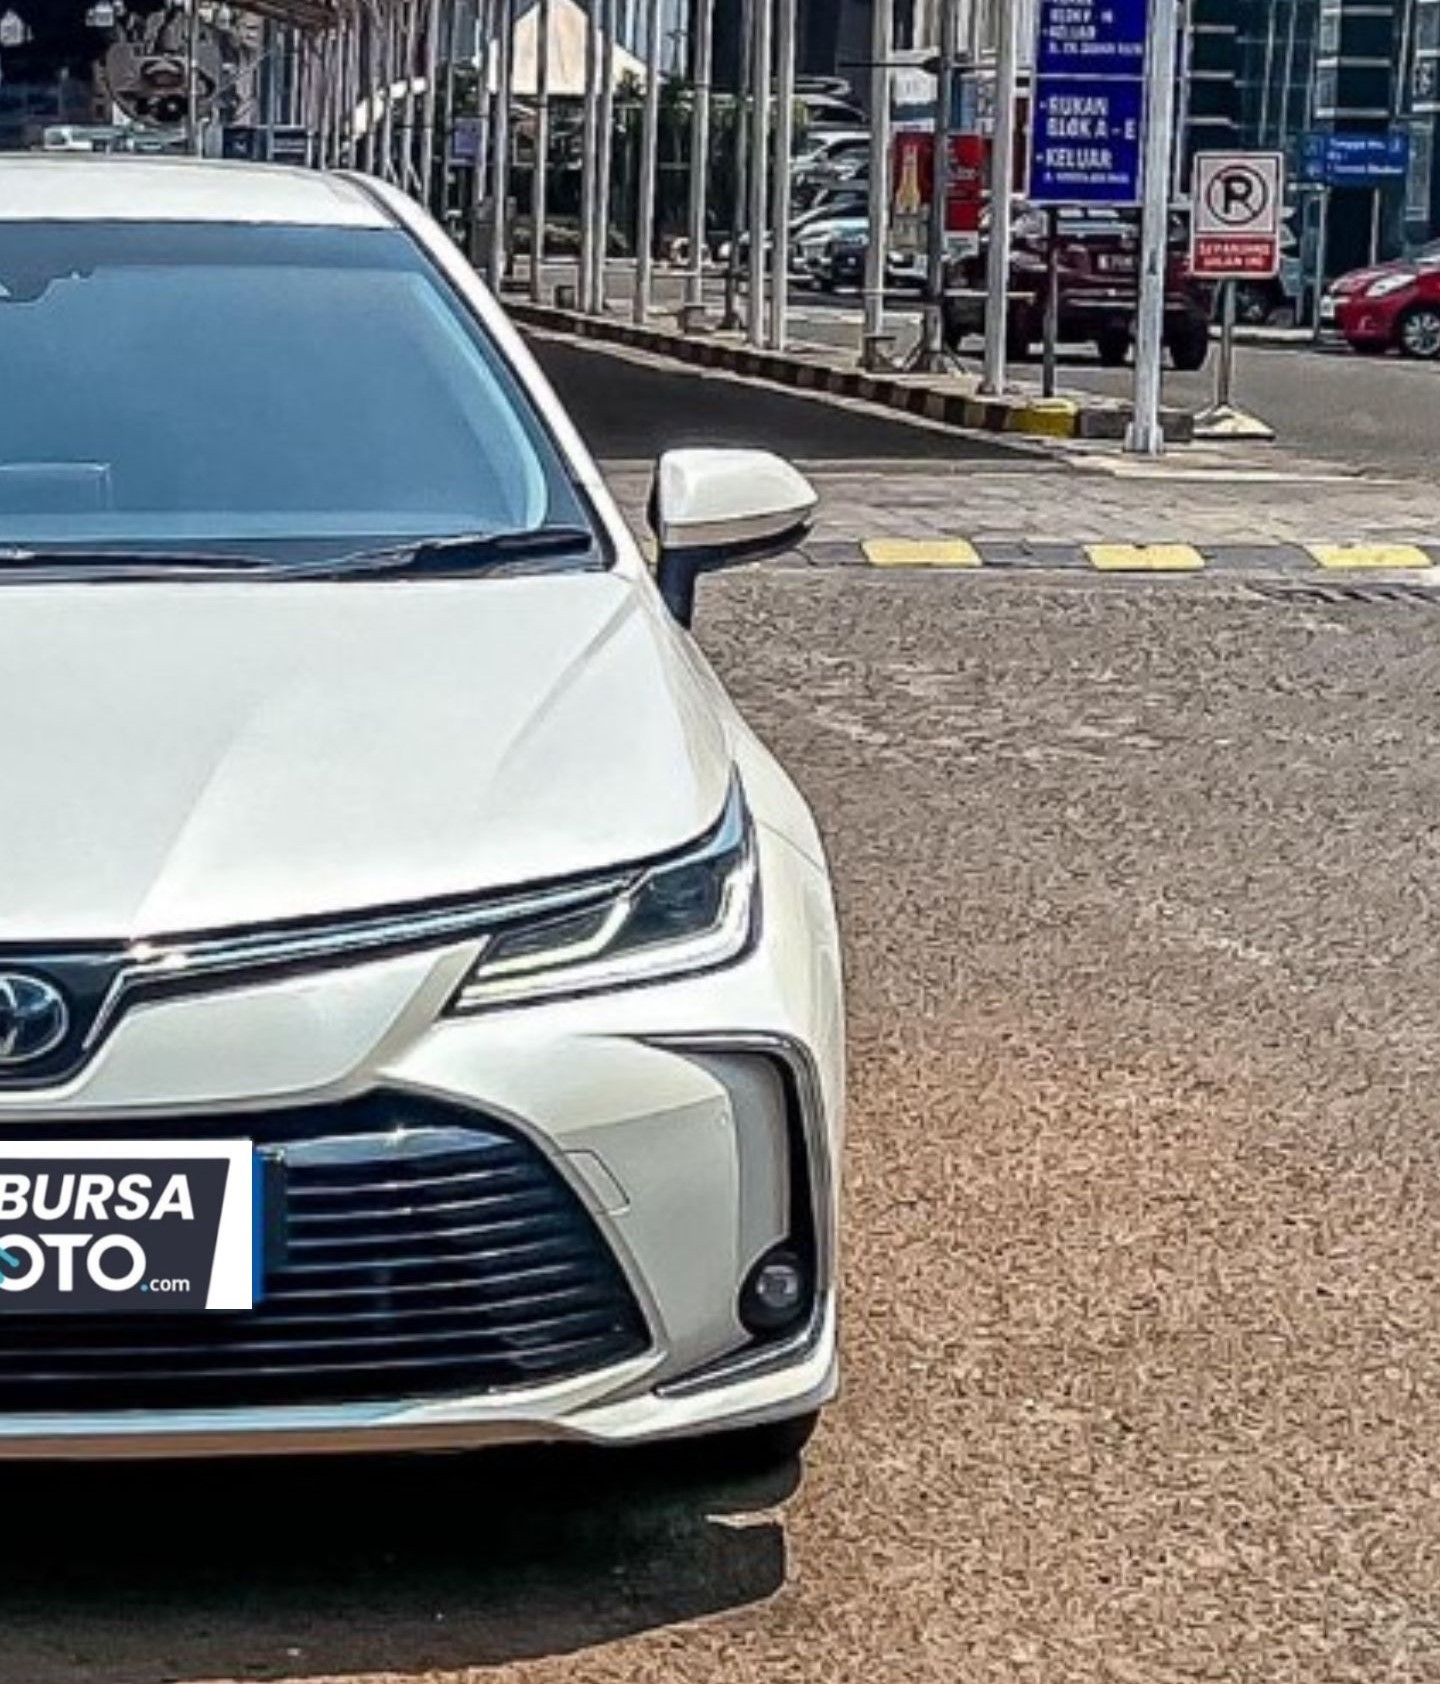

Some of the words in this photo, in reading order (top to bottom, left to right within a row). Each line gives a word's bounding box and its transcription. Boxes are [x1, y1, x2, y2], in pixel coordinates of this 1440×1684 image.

[1049, 96, 1109, 116] RUKAN
[1046, 117, 1092, 138] BLOK
[1124, 118, 1137, 140] E
[1045, 148, 1113, 171] KELUAR
